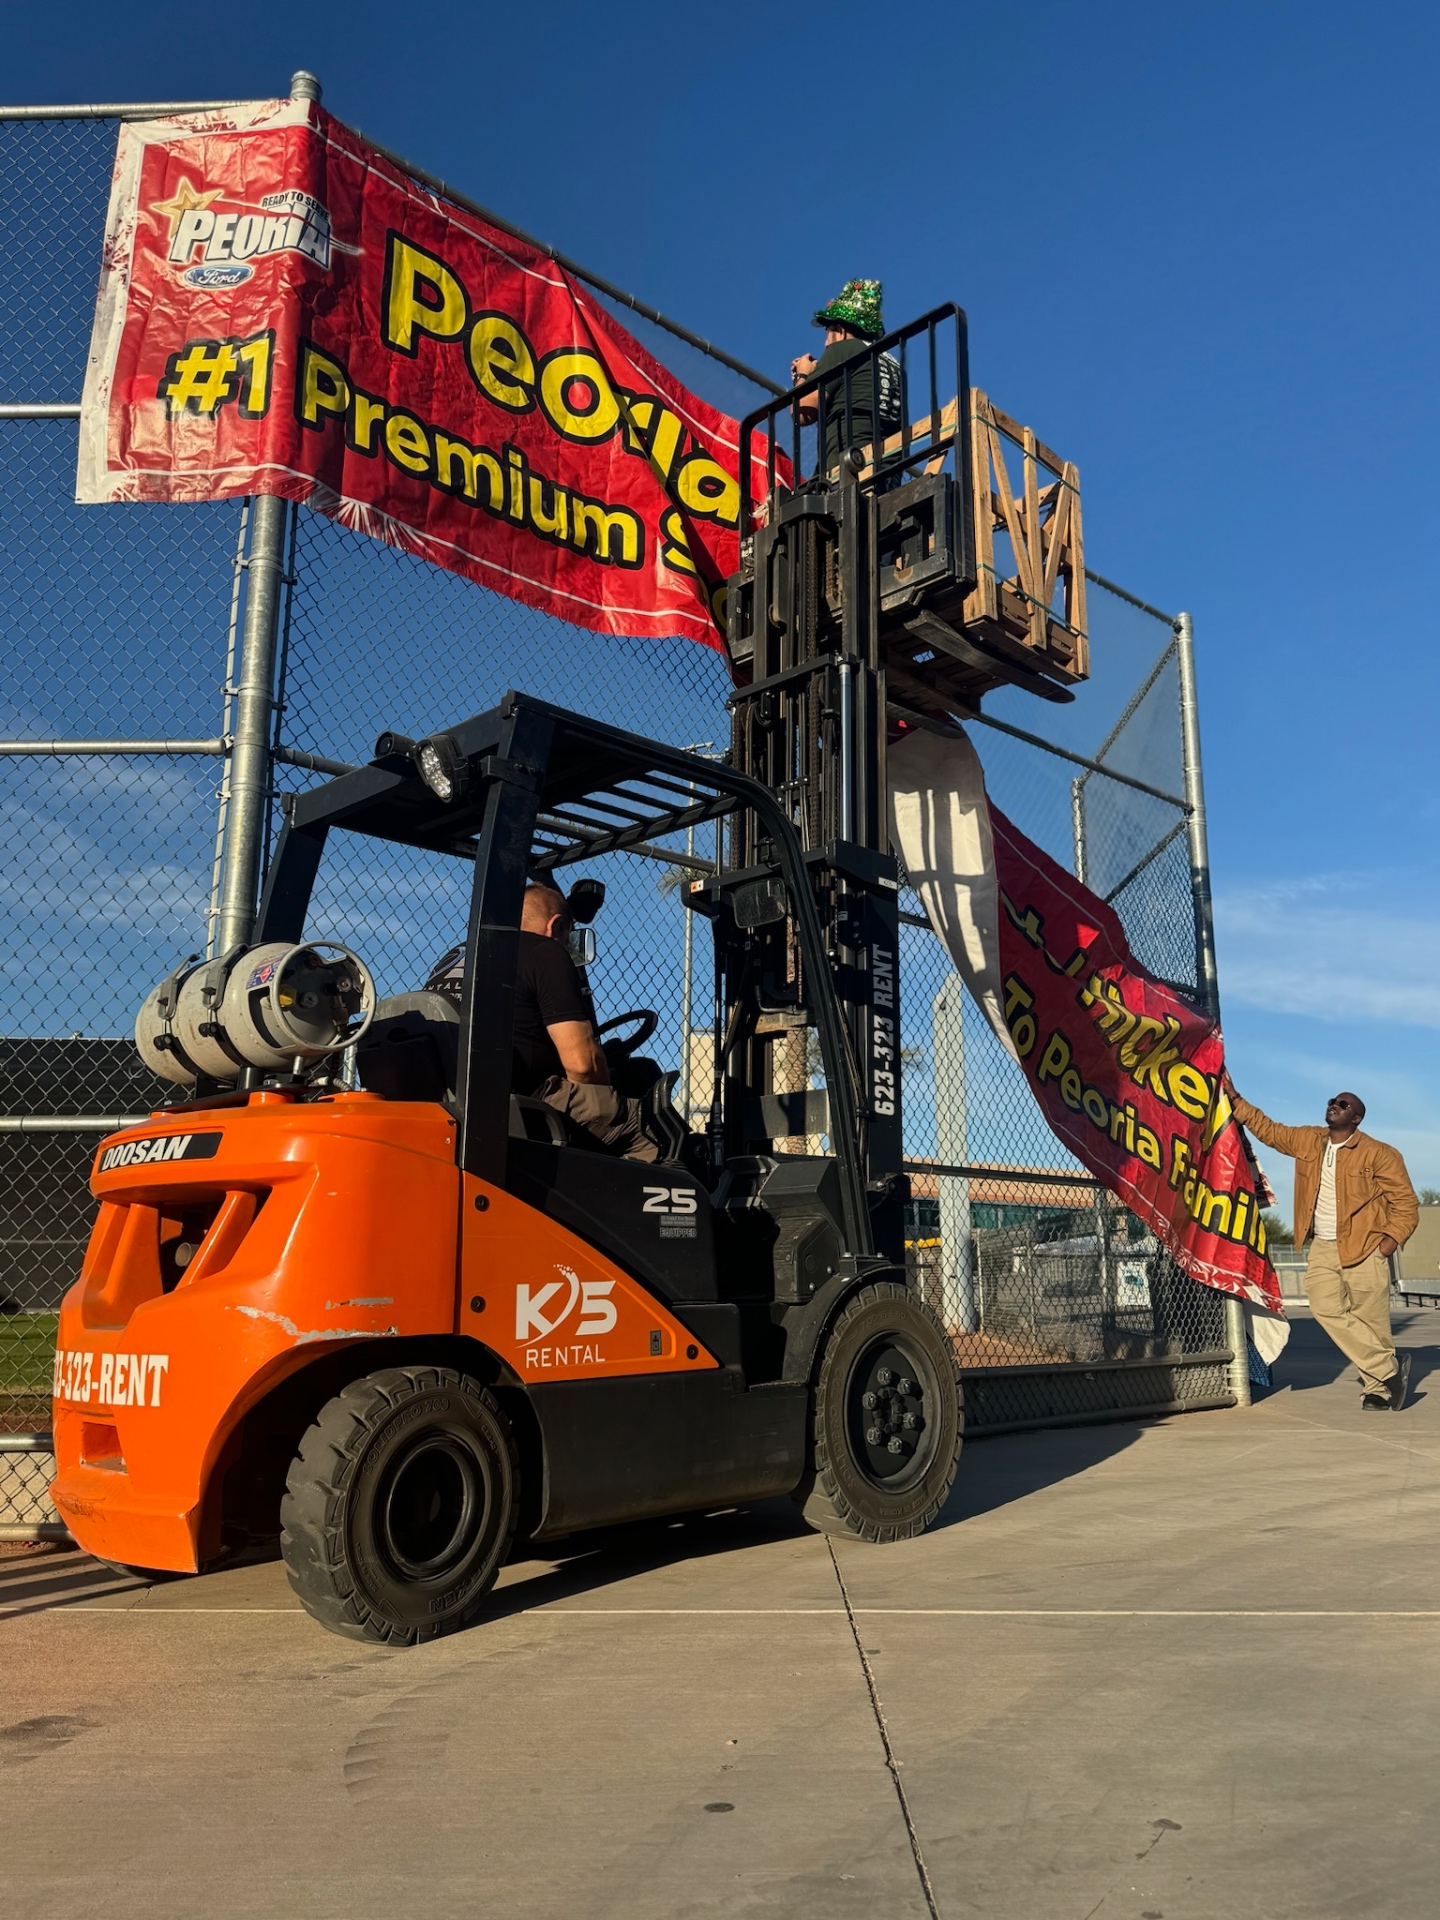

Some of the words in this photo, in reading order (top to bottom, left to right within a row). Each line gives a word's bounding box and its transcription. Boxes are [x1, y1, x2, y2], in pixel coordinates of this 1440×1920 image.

[169, 201, 331, 270] PEORIA
[262, 191, 289, 208] READY
[291, 191, 303, 202] TO
[304, 195, 330, 221] SERVE
[197, 267, 241, 285] Ford
[162, 334, 273, 417] #1
[298, 345, 640, 564] Premium
[872, 943, 894, 1009] RENT
[874, 1014, 895, 1116] 623-323
[1004, 976, 1036, 1056] To
[1039, 1037, 1161, 1170] Peoria
[101, 1134, 192, 1171] DOOSAN
[643, 1186, 698, 1214] 25
[525, 1344, 606, 1369] RENTAL
[363, 1404, 423, 1476] SOLIDPRO
